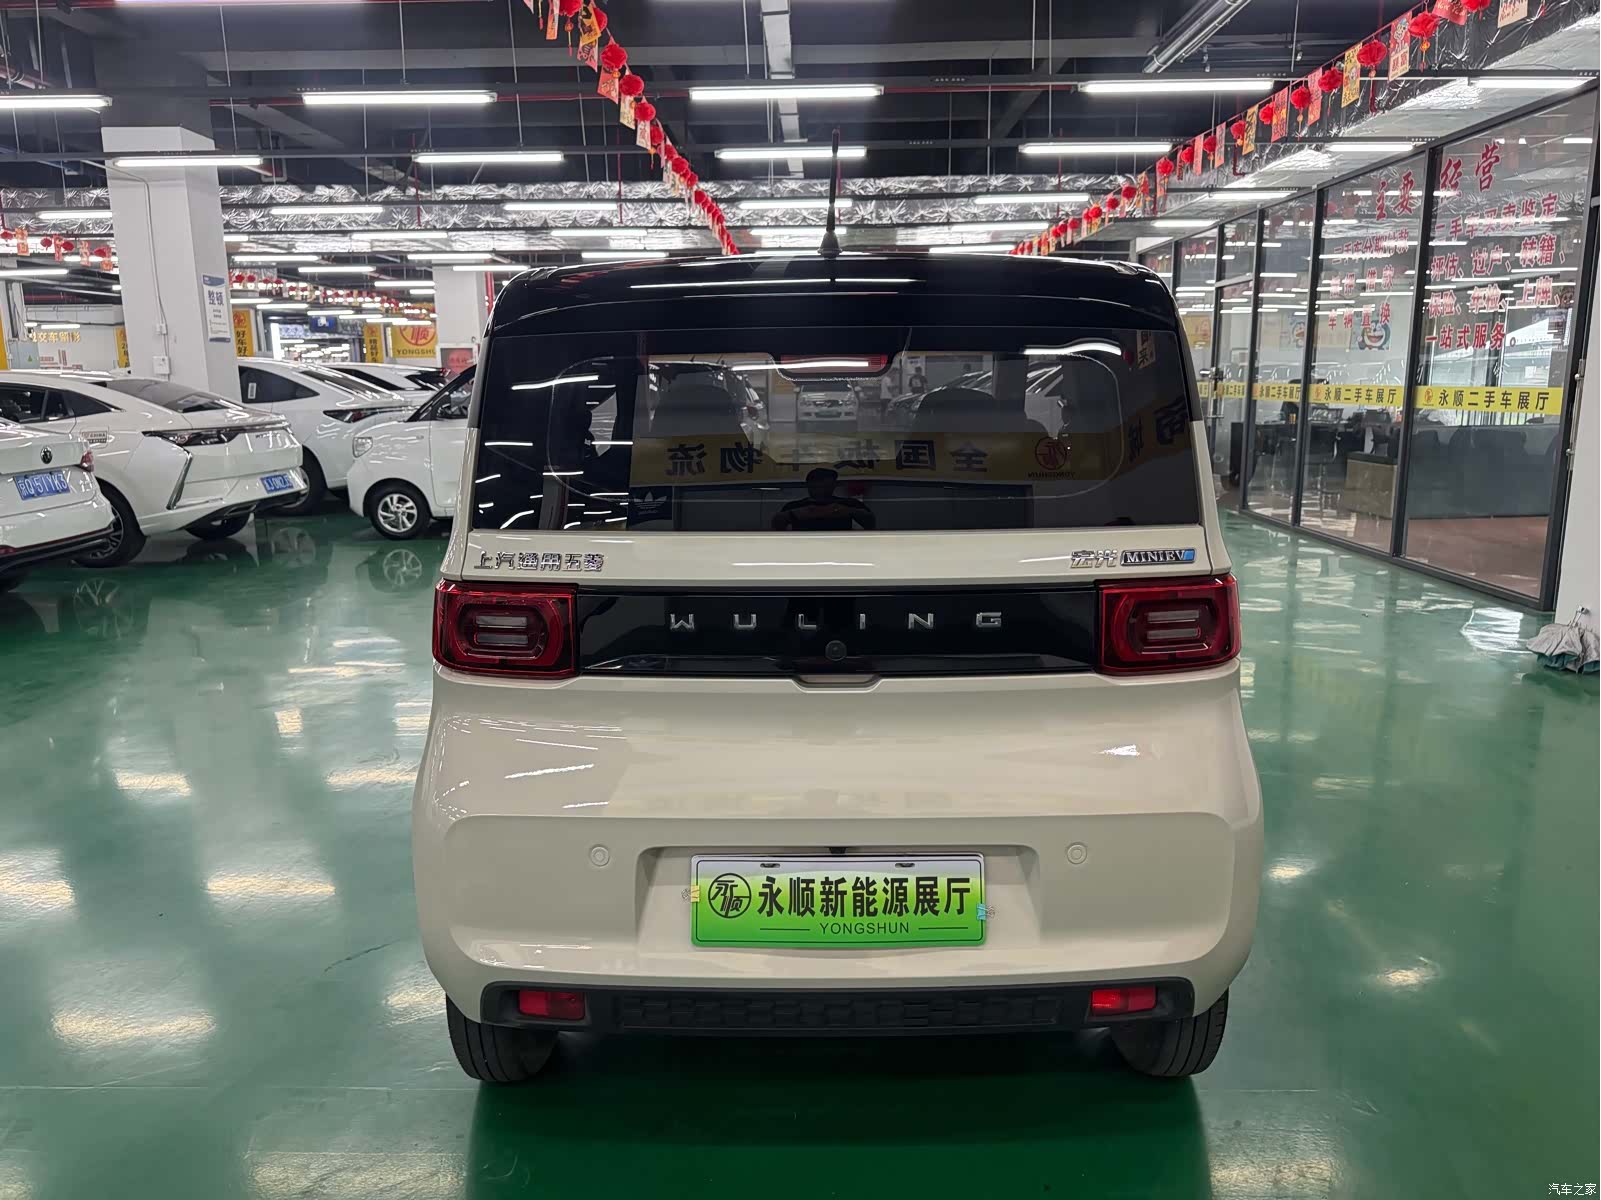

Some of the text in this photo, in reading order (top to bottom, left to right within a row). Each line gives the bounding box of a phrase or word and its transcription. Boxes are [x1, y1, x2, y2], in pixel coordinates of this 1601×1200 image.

[1434, 193, 1559, 242] 二手车买卖鉴定
[1324, 387, 1397, 405] 永顺二手车展厅
[1438, 389, 1550, 411] 永顺二手车展厅
[473, 550, 604, 572] 上汽通用五菱
[1125, 550, 1186, 563] MINIEV
[670, 612, 1002, 630] WULING
[757, 875, 971, 919] 永顺新能源展厅
[819, 922, 910, 935] YONGSHUN
